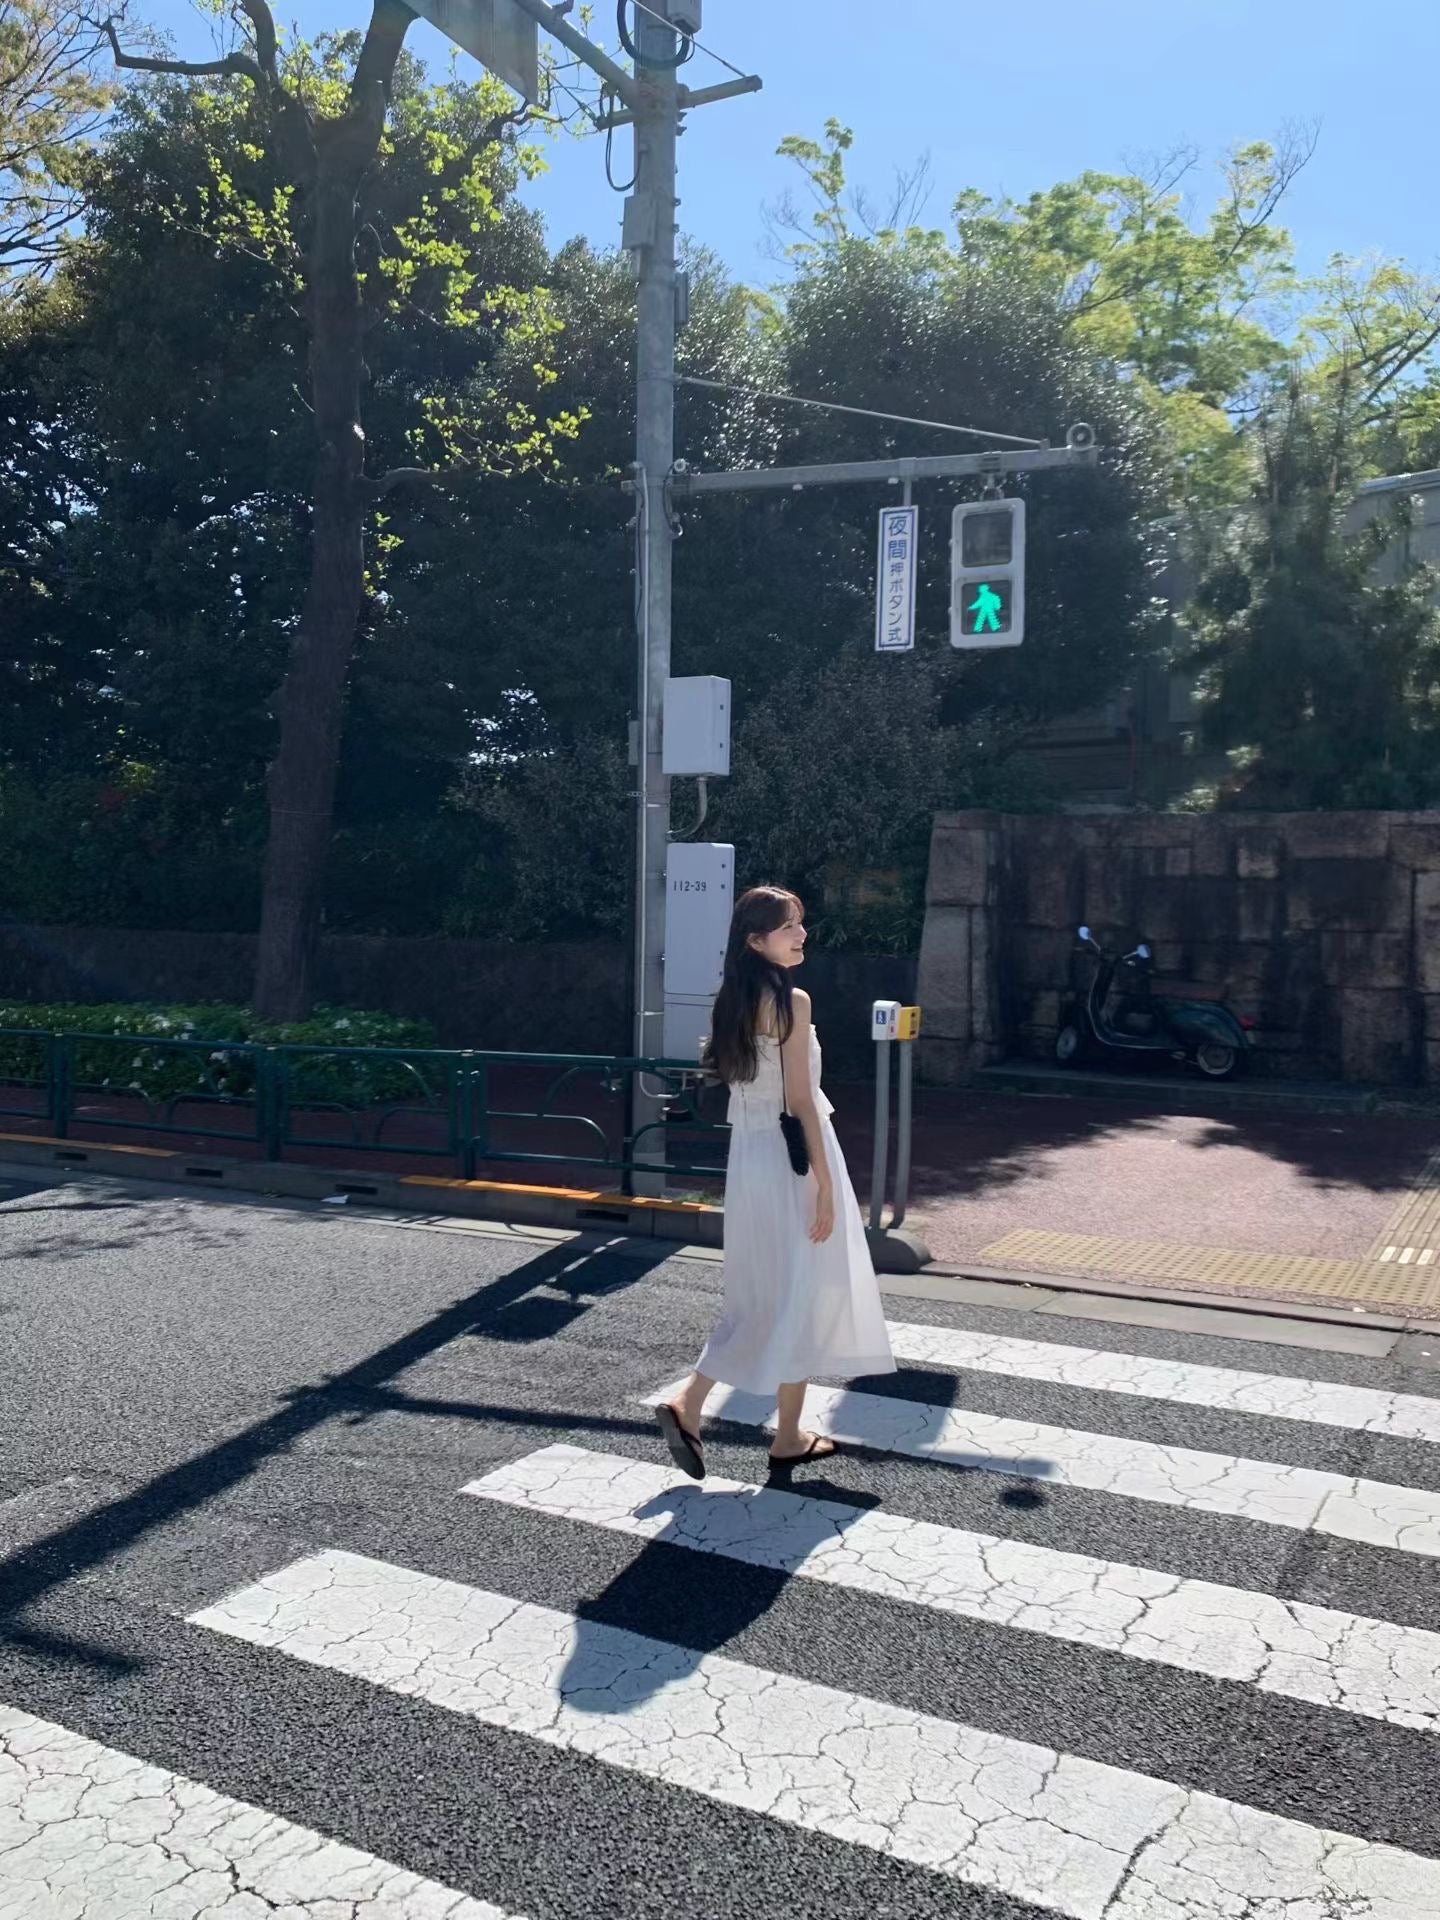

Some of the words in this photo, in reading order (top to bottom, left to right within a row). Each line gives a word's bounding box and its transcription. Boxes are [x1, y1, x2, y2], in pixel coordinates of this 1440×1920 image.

[888, 515, 909, 642] 夜間押ボタン式
[673, 881, 707, 892] 112-39
